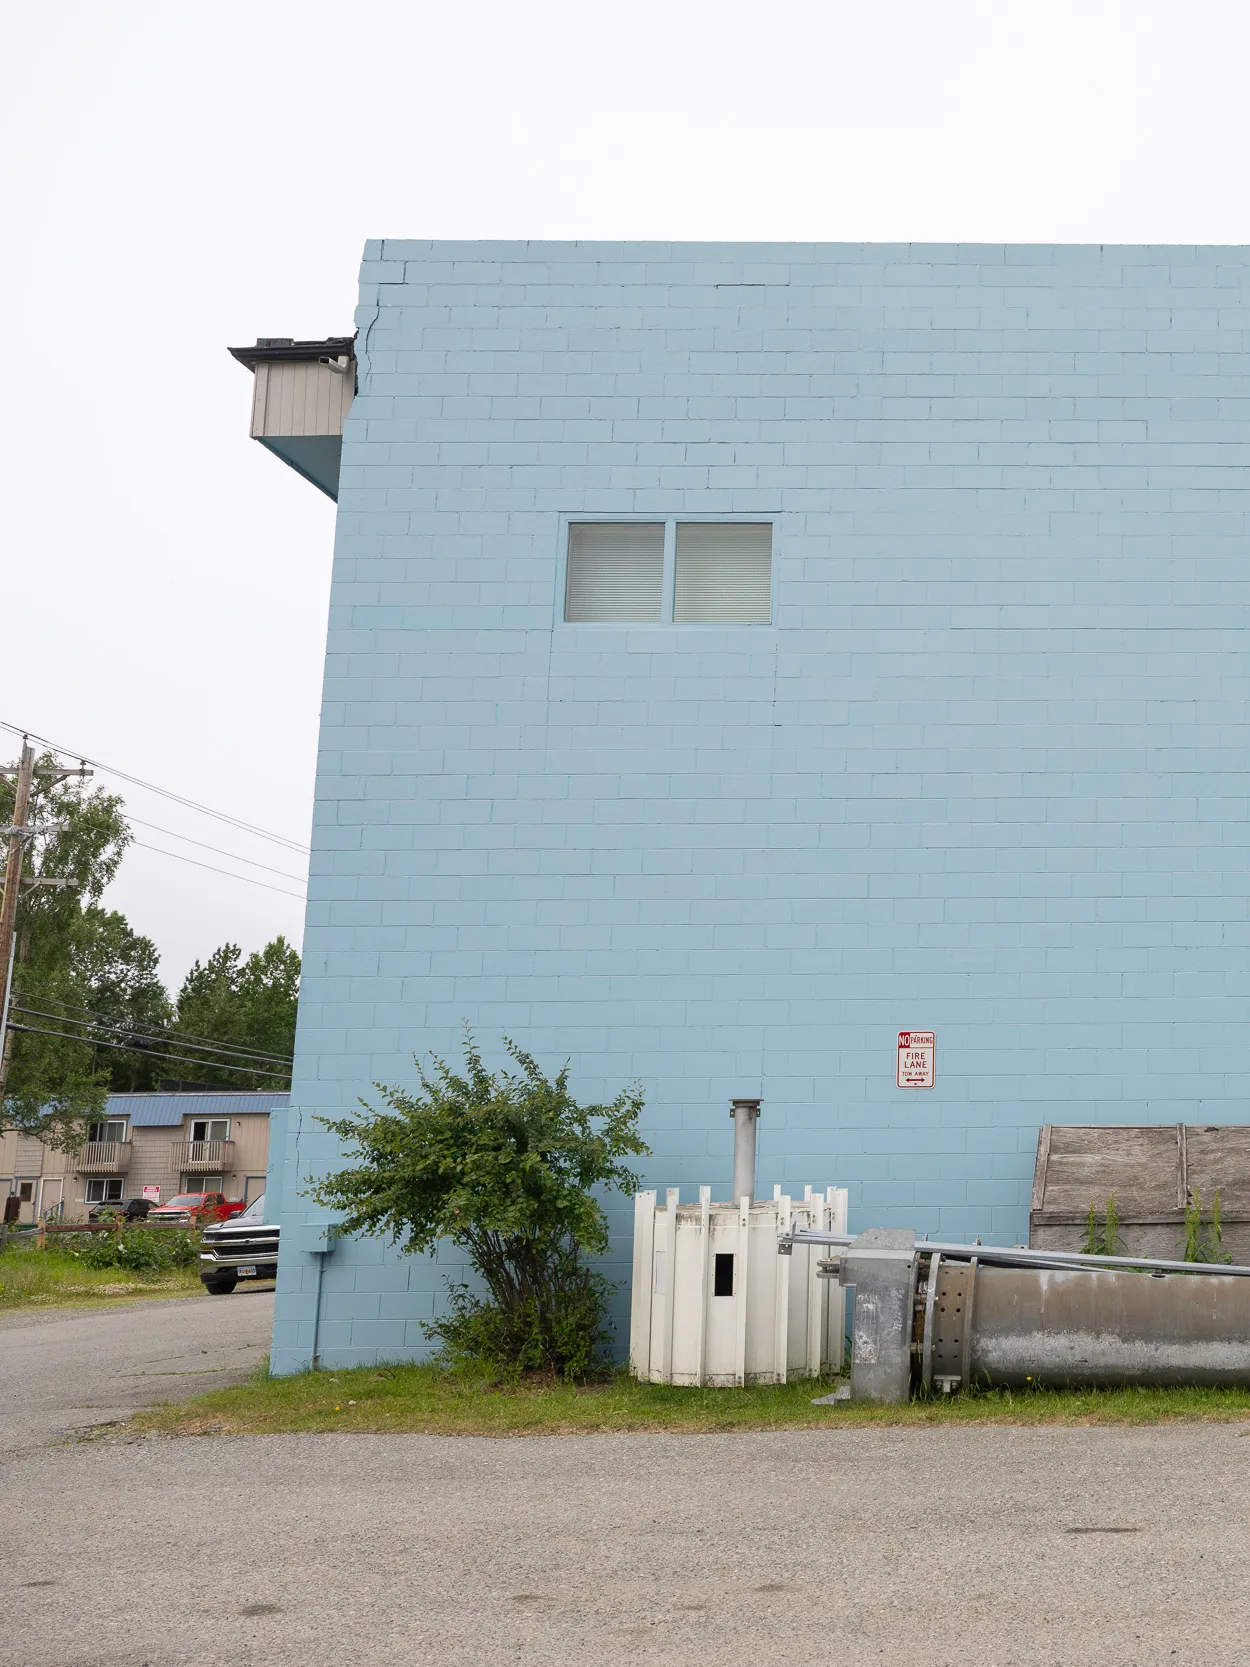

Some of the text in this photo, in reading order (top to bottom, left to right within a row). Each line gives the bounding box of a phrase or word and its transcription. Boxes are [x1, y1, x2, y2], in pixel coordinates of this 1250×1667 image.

[899, 1035, 933, 1046] NO PARKING
[906, 1052, 926, 1060] FIRE
[904, 1061, 927, 1069] LANE
